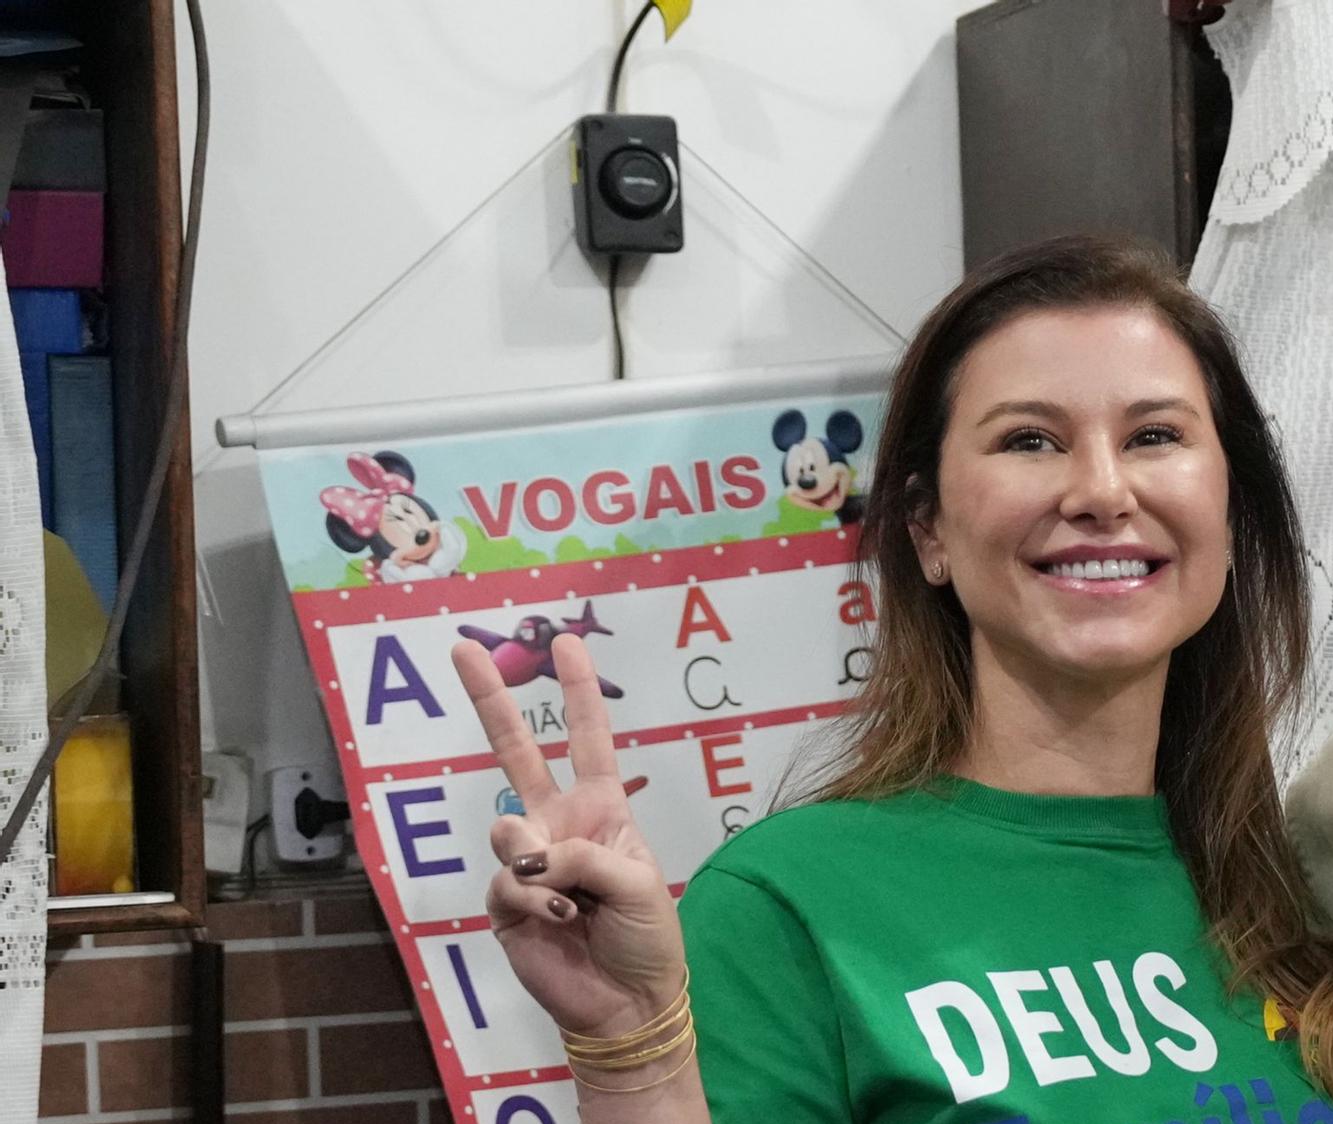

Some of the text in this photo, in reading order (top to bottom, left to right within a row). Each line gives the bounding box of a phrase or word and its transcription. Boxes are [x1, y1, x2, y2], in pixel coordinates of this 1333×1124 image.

[463, 455, 767, 540] VOGAIS
[675, 585, 733, 650] A
[366, 635, 447, 725] A
[701, 733, 754, 798] E
[386, 785, 466, 878] E
[446, 943, 489, 1030] I
[905, 952, 1218, 1104] DEUS
